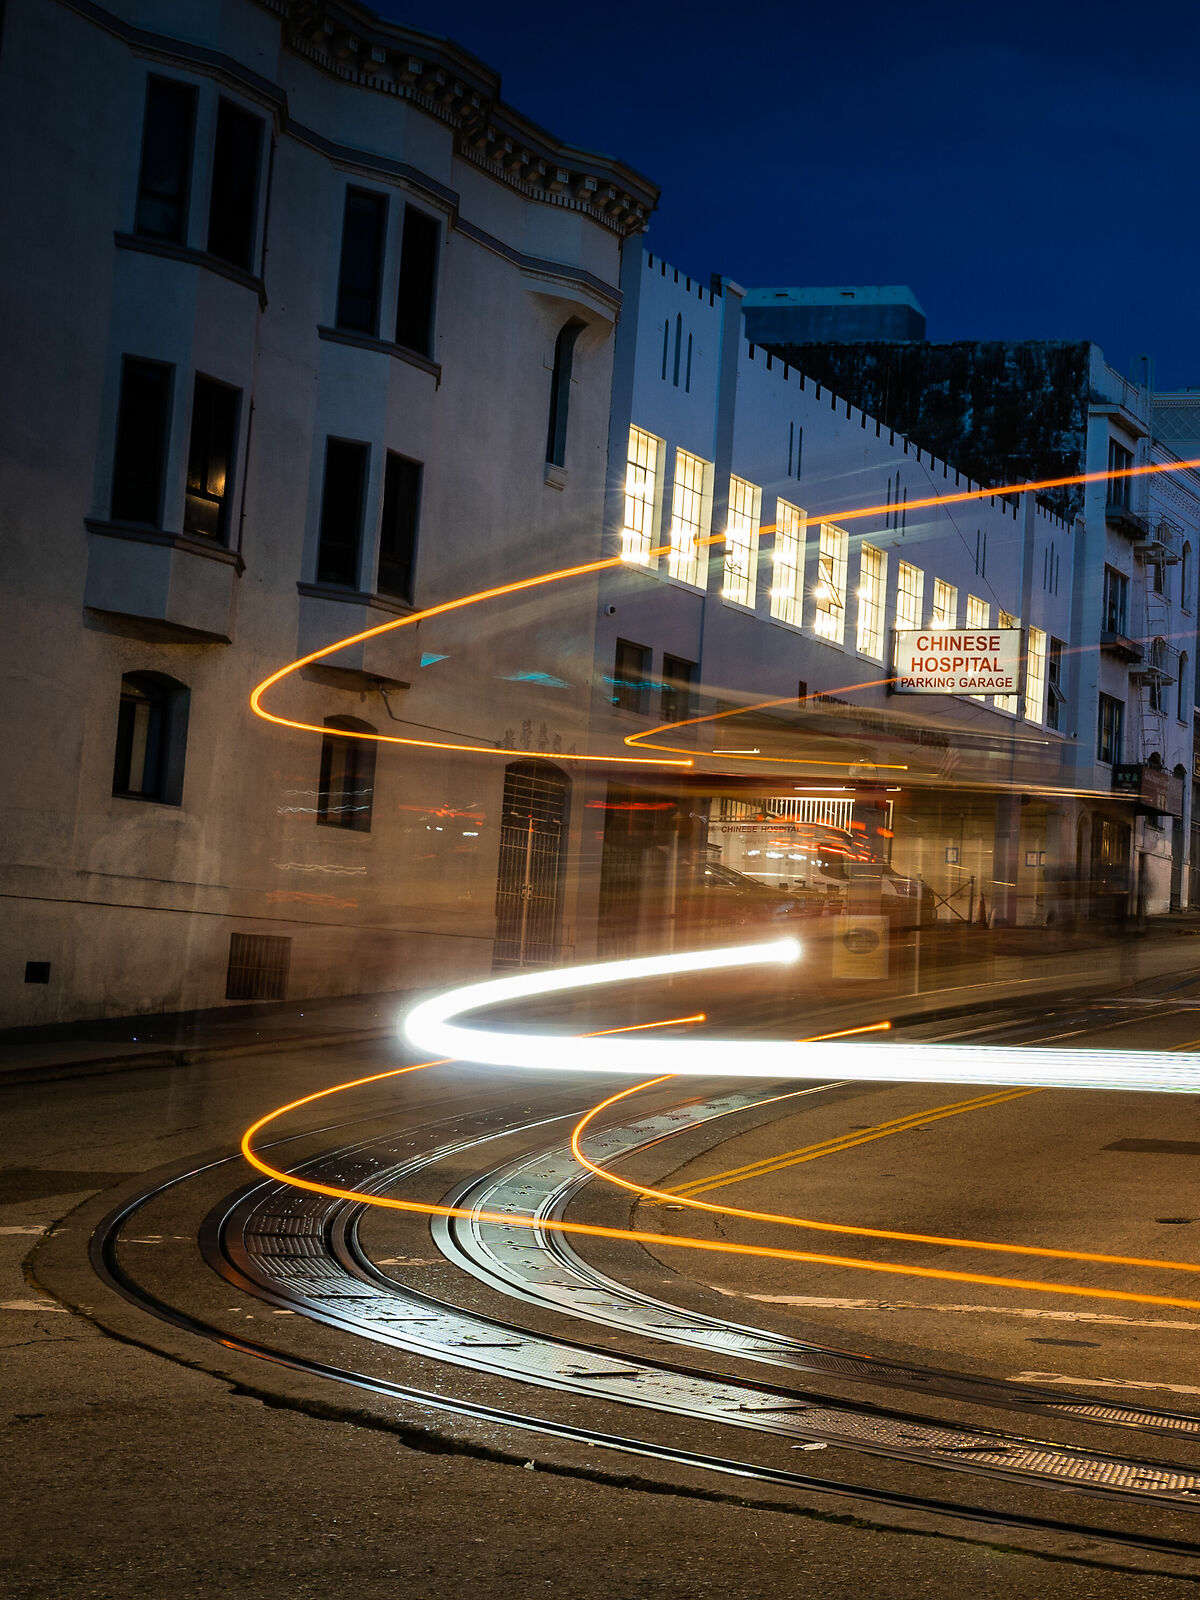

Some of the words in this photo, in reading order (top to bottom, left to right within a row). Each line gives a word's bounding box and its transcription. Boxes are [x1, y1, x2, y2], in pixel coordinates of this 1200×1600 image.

[917, 636, 1001, 651] CHINESE
[911, 657, 1004, 672] HOSPITAL
[900, 677, 955, 688] PARKING
[959, 677, 1013, 688] GARAGE
